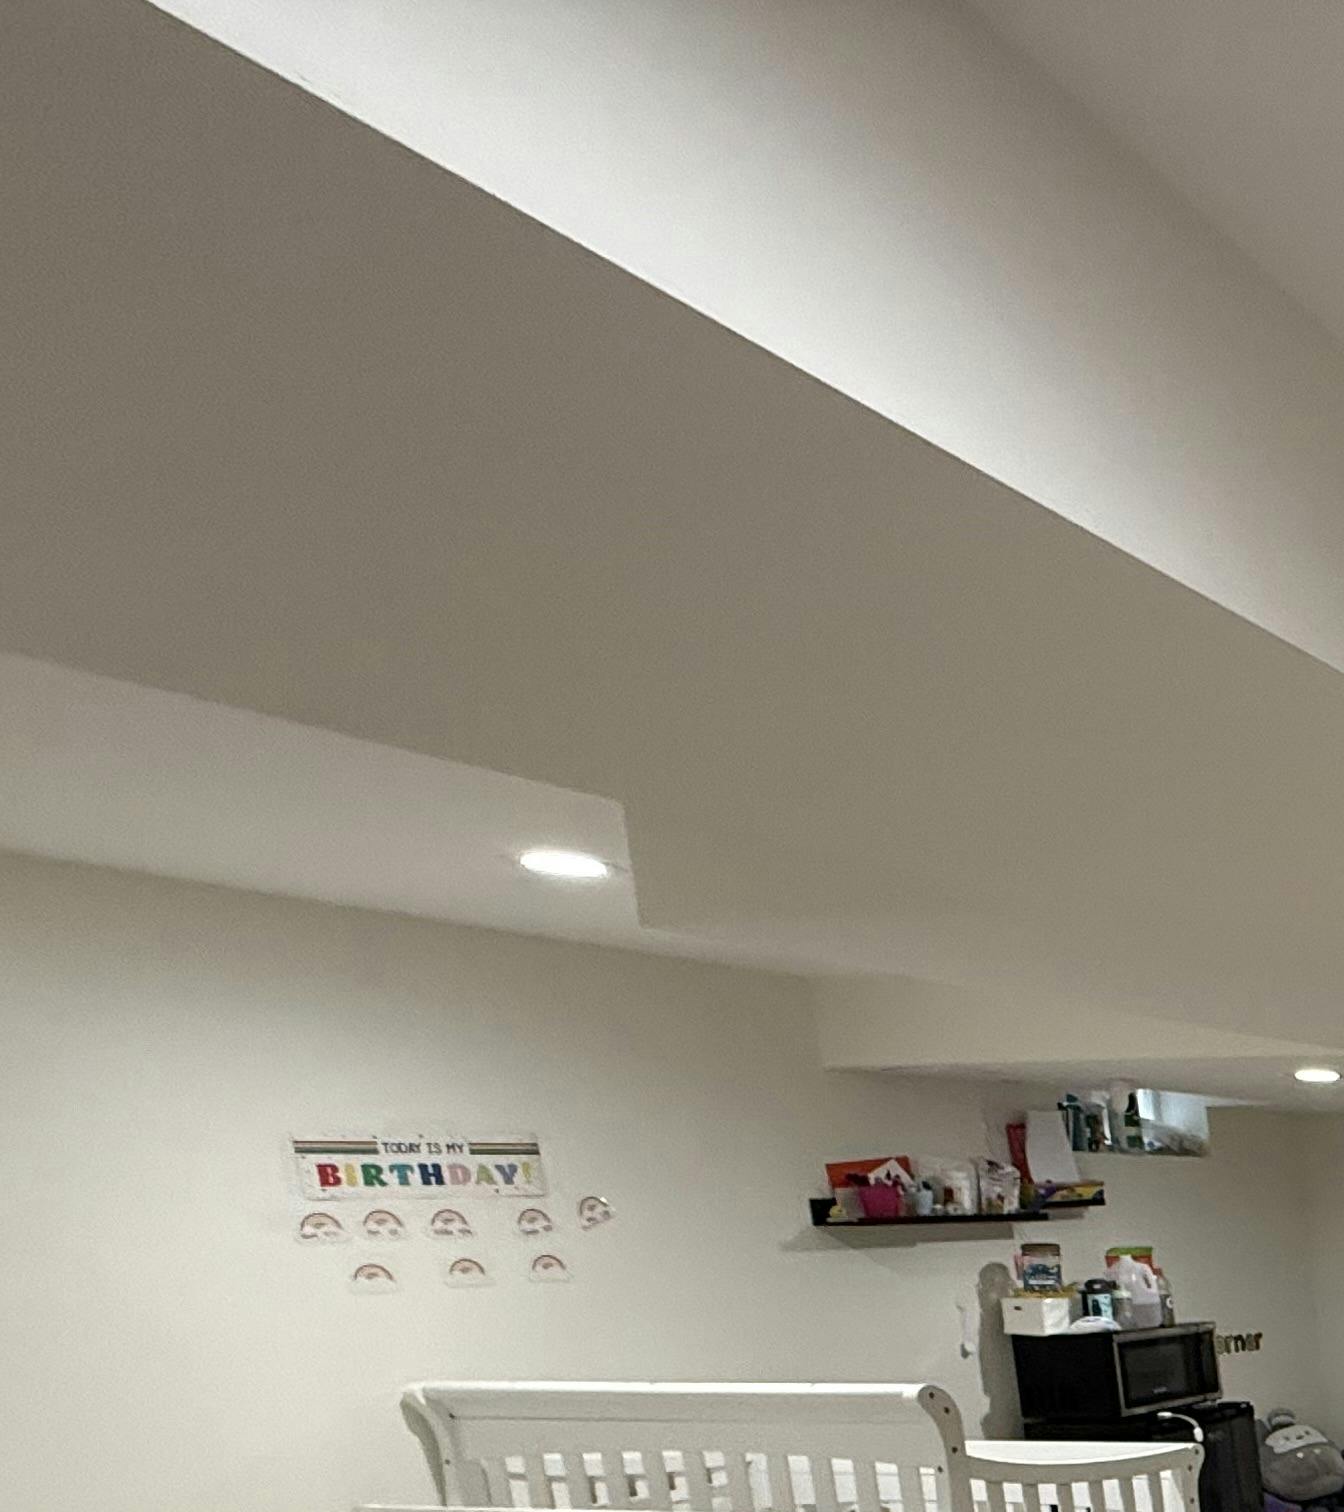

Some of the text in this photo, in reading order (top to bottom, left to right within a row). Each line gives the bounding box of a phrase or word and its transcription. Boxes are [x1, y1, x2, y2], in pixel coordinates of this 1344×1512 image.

[381, 1141, 464, 1155] TODAY IS MY
[315, 1160, 535, 1188] BIRTHDAY!
[1216, 1332, 1263, 1355] orner
